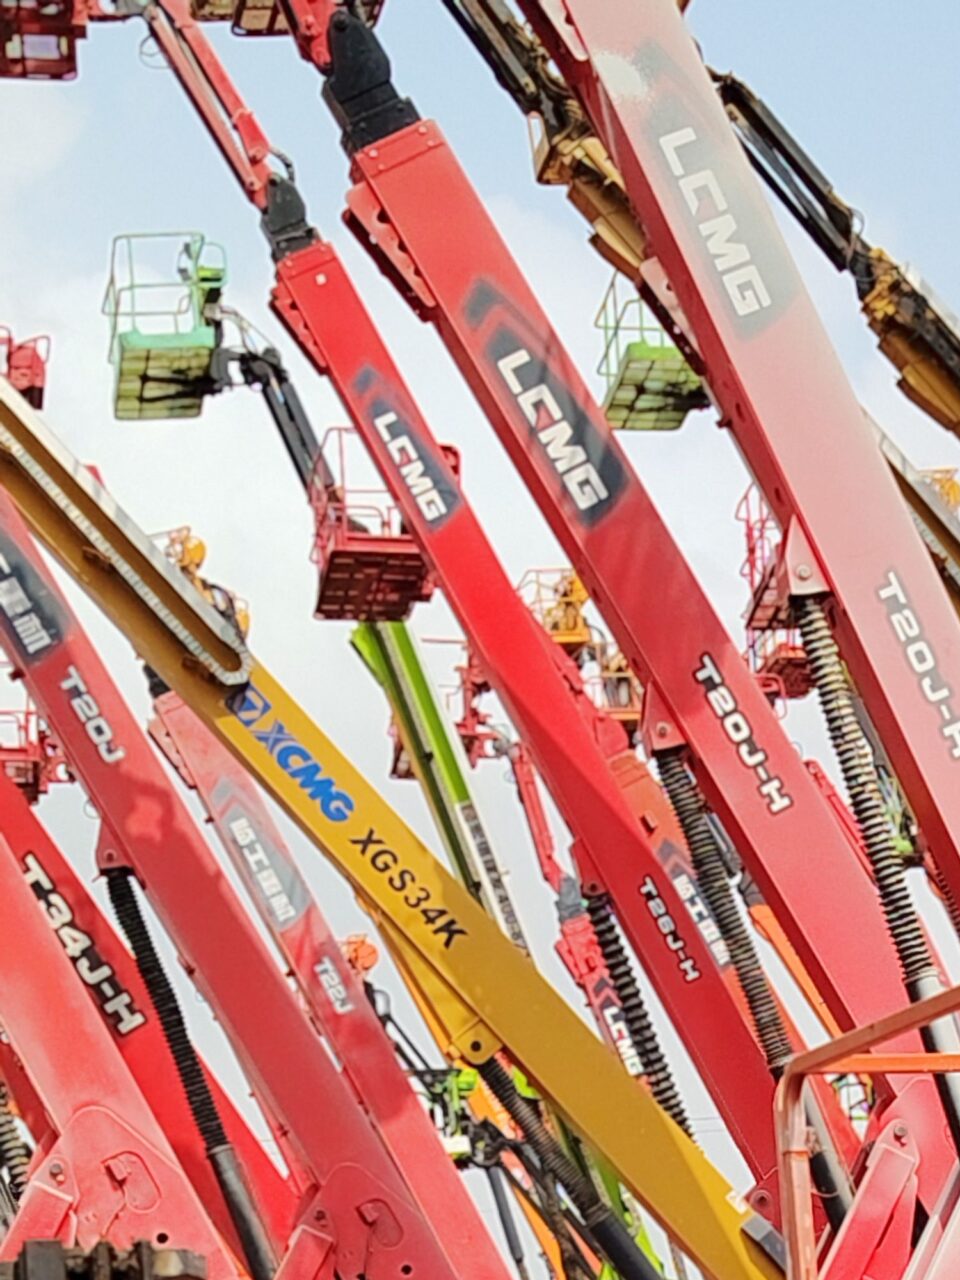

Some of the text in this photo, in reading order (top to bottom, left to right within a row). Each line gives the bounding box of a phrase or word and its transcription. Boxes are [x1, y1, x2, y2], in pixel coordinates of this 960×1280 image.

[659, 128, 771, 316] LCMG
[373, 411, 446, 520] LCMG
[498, 350, 608, 510] LCMG
[60, 664, 125, 762] T20J
[253, 719, 468, 949] XCMG XGS34K
[23, 853, 146, 1035] T34J-H
[603, 1005, 645, 1077] LCMG
